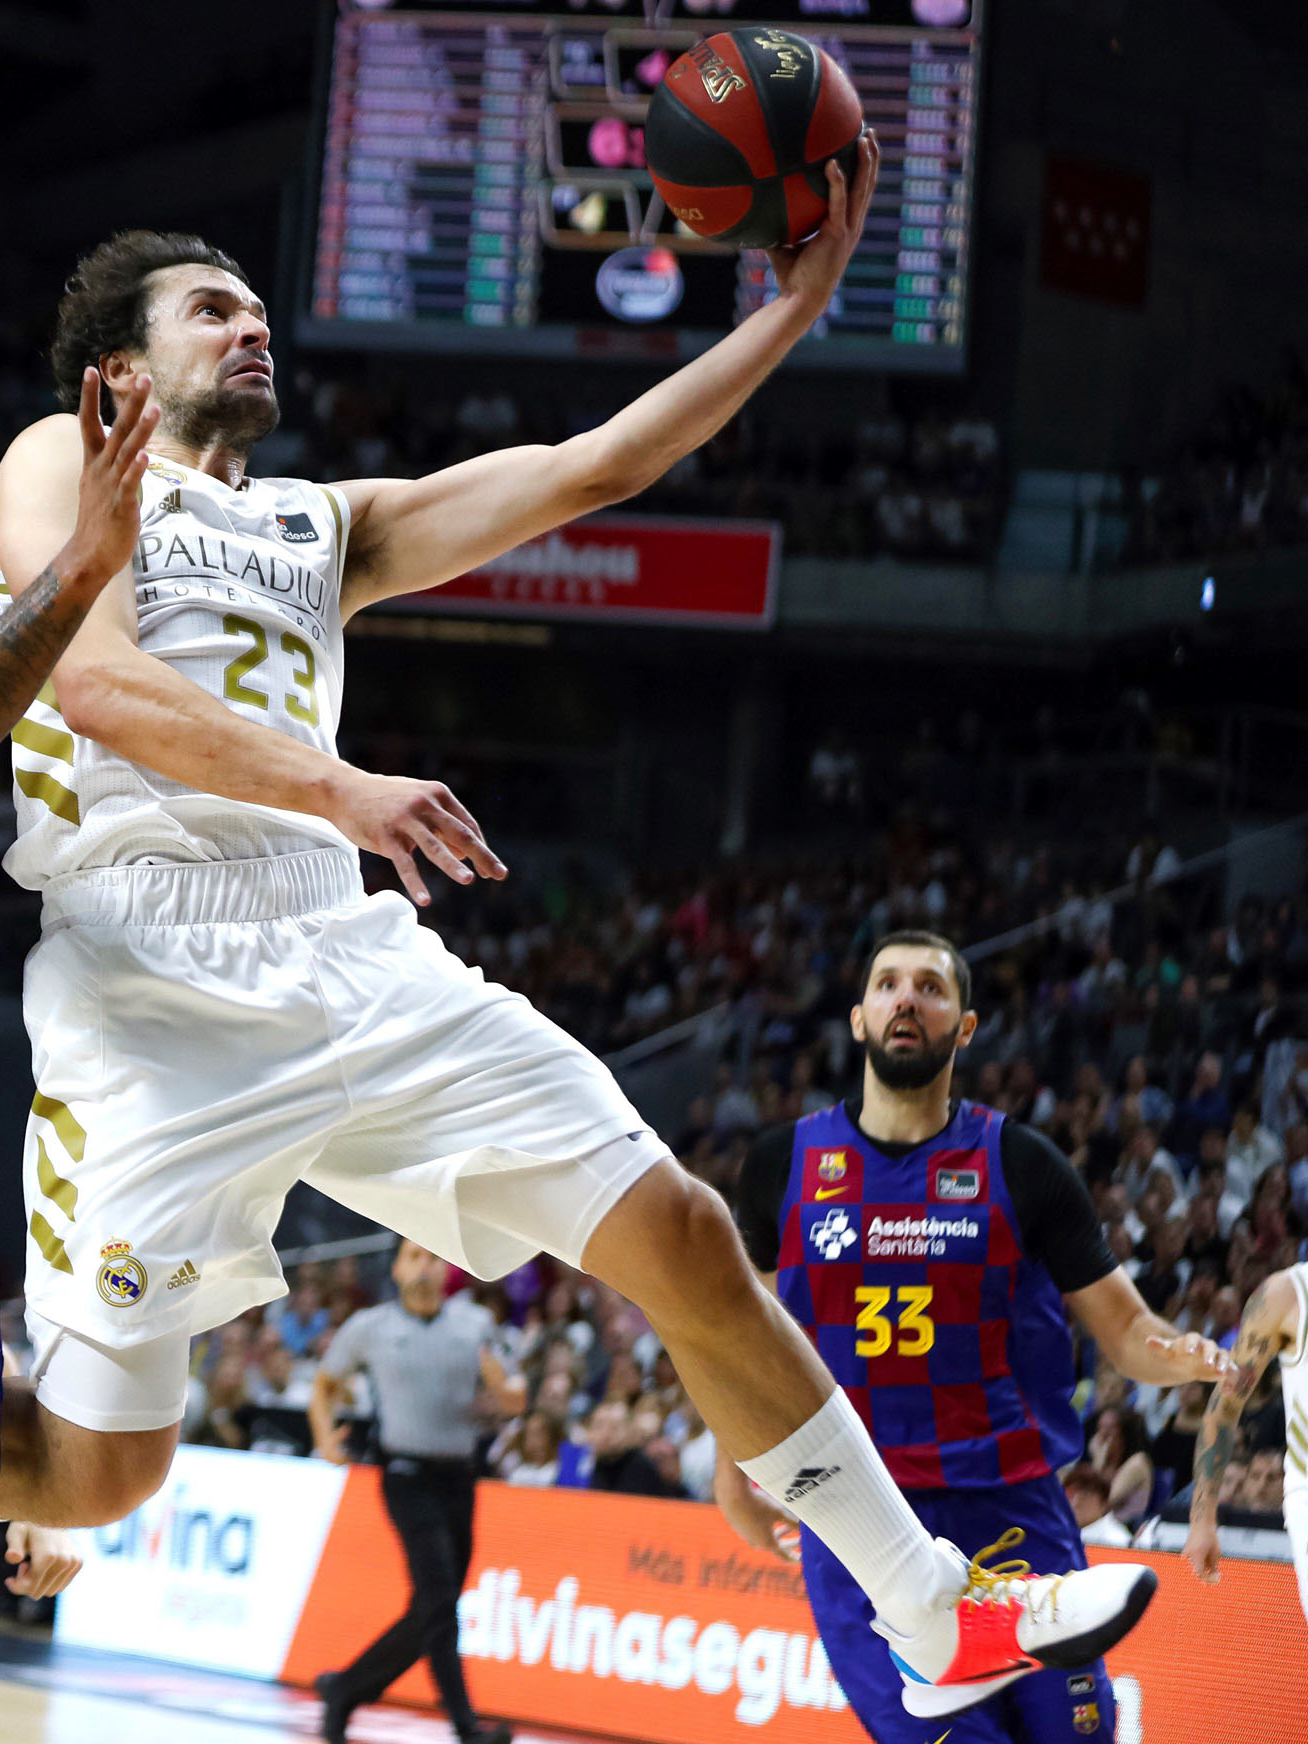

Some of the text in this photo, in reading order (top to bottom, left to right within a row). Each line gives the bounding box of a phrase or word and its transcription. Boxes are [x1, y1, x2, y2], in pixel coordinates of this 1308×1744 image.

[280, 531, 316, 541] ndesa
[140, 534, 327, 617] PALLADIU
[223, 613, 320, 730] 23
[167, 1273, 201, 1291] adidas
[854, 1285, 936, 1358] 33
